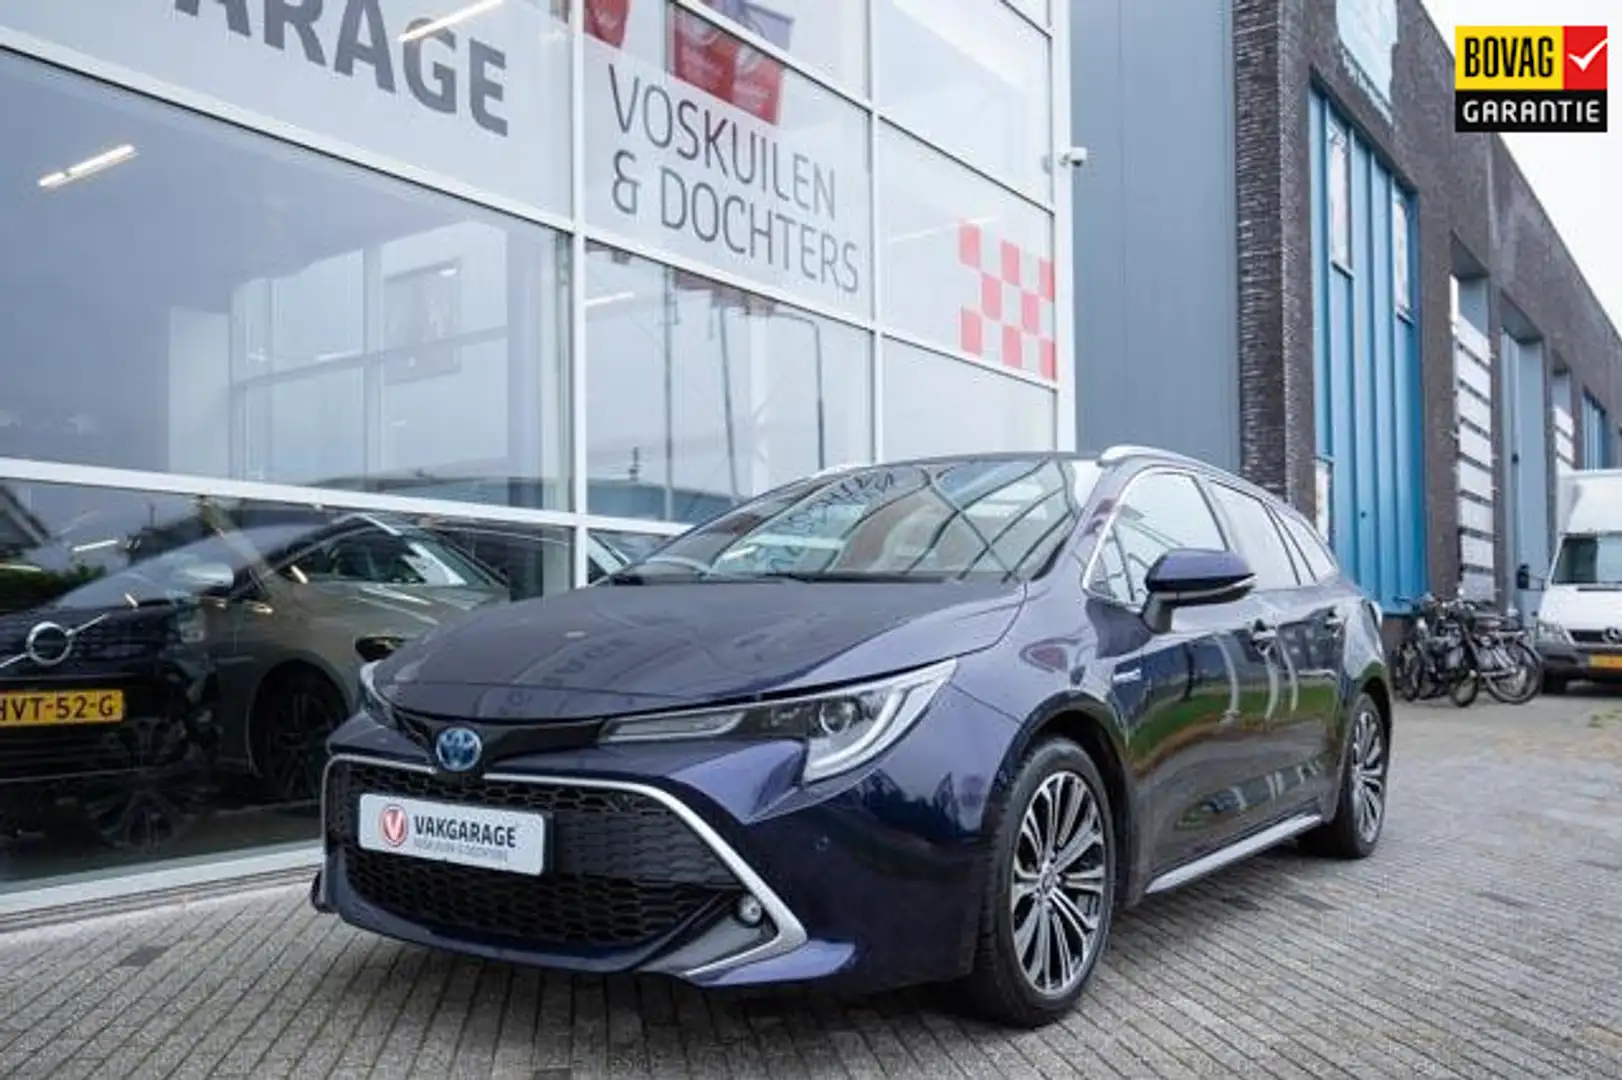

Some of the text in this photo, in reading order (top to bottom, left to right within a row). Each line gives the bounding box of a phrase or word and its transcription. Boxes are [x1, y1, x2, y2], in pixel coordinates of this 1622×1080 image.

[174, 0, 508, 137] RAGE
[609, 63, 835, 220] VOSKUILEN
[612, 149, 859, 294] & DOCHTERS
[414, 815, 516, 849] VAKGARAGE
